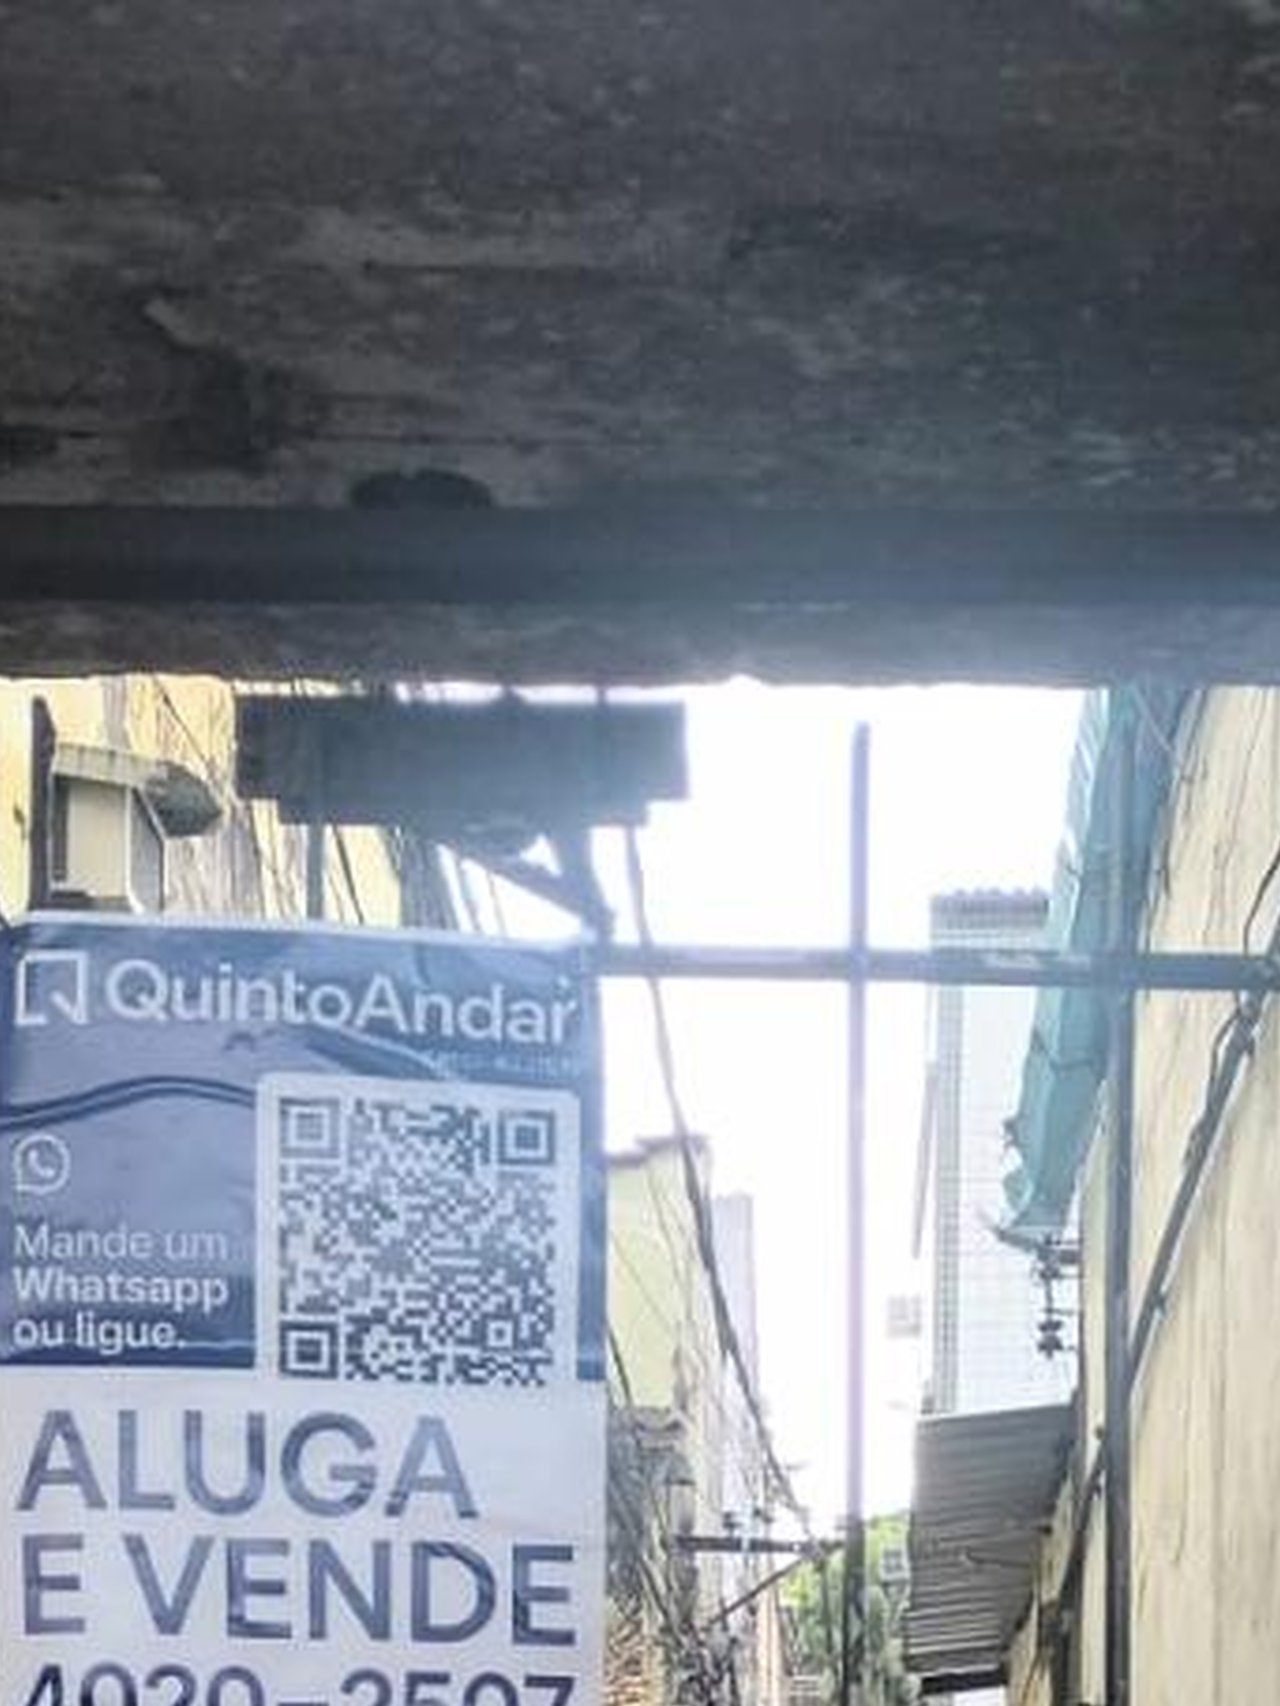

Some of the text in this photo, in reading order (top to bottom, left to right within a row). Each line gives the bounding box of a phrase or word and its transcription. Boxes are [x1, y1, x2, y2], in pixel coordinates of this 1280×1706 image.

[104, 957, 579, 1044] QuintoAndar
[15, 1222, 228, 1261] Mande um
[12, 1265, 230, 1314] Whatsapp
[13, 1310, 186, 1356] ou ligue.
[15, 1409, 480, 1519] ALUGA
[21, 1533, 577, 1647] E VENDE
